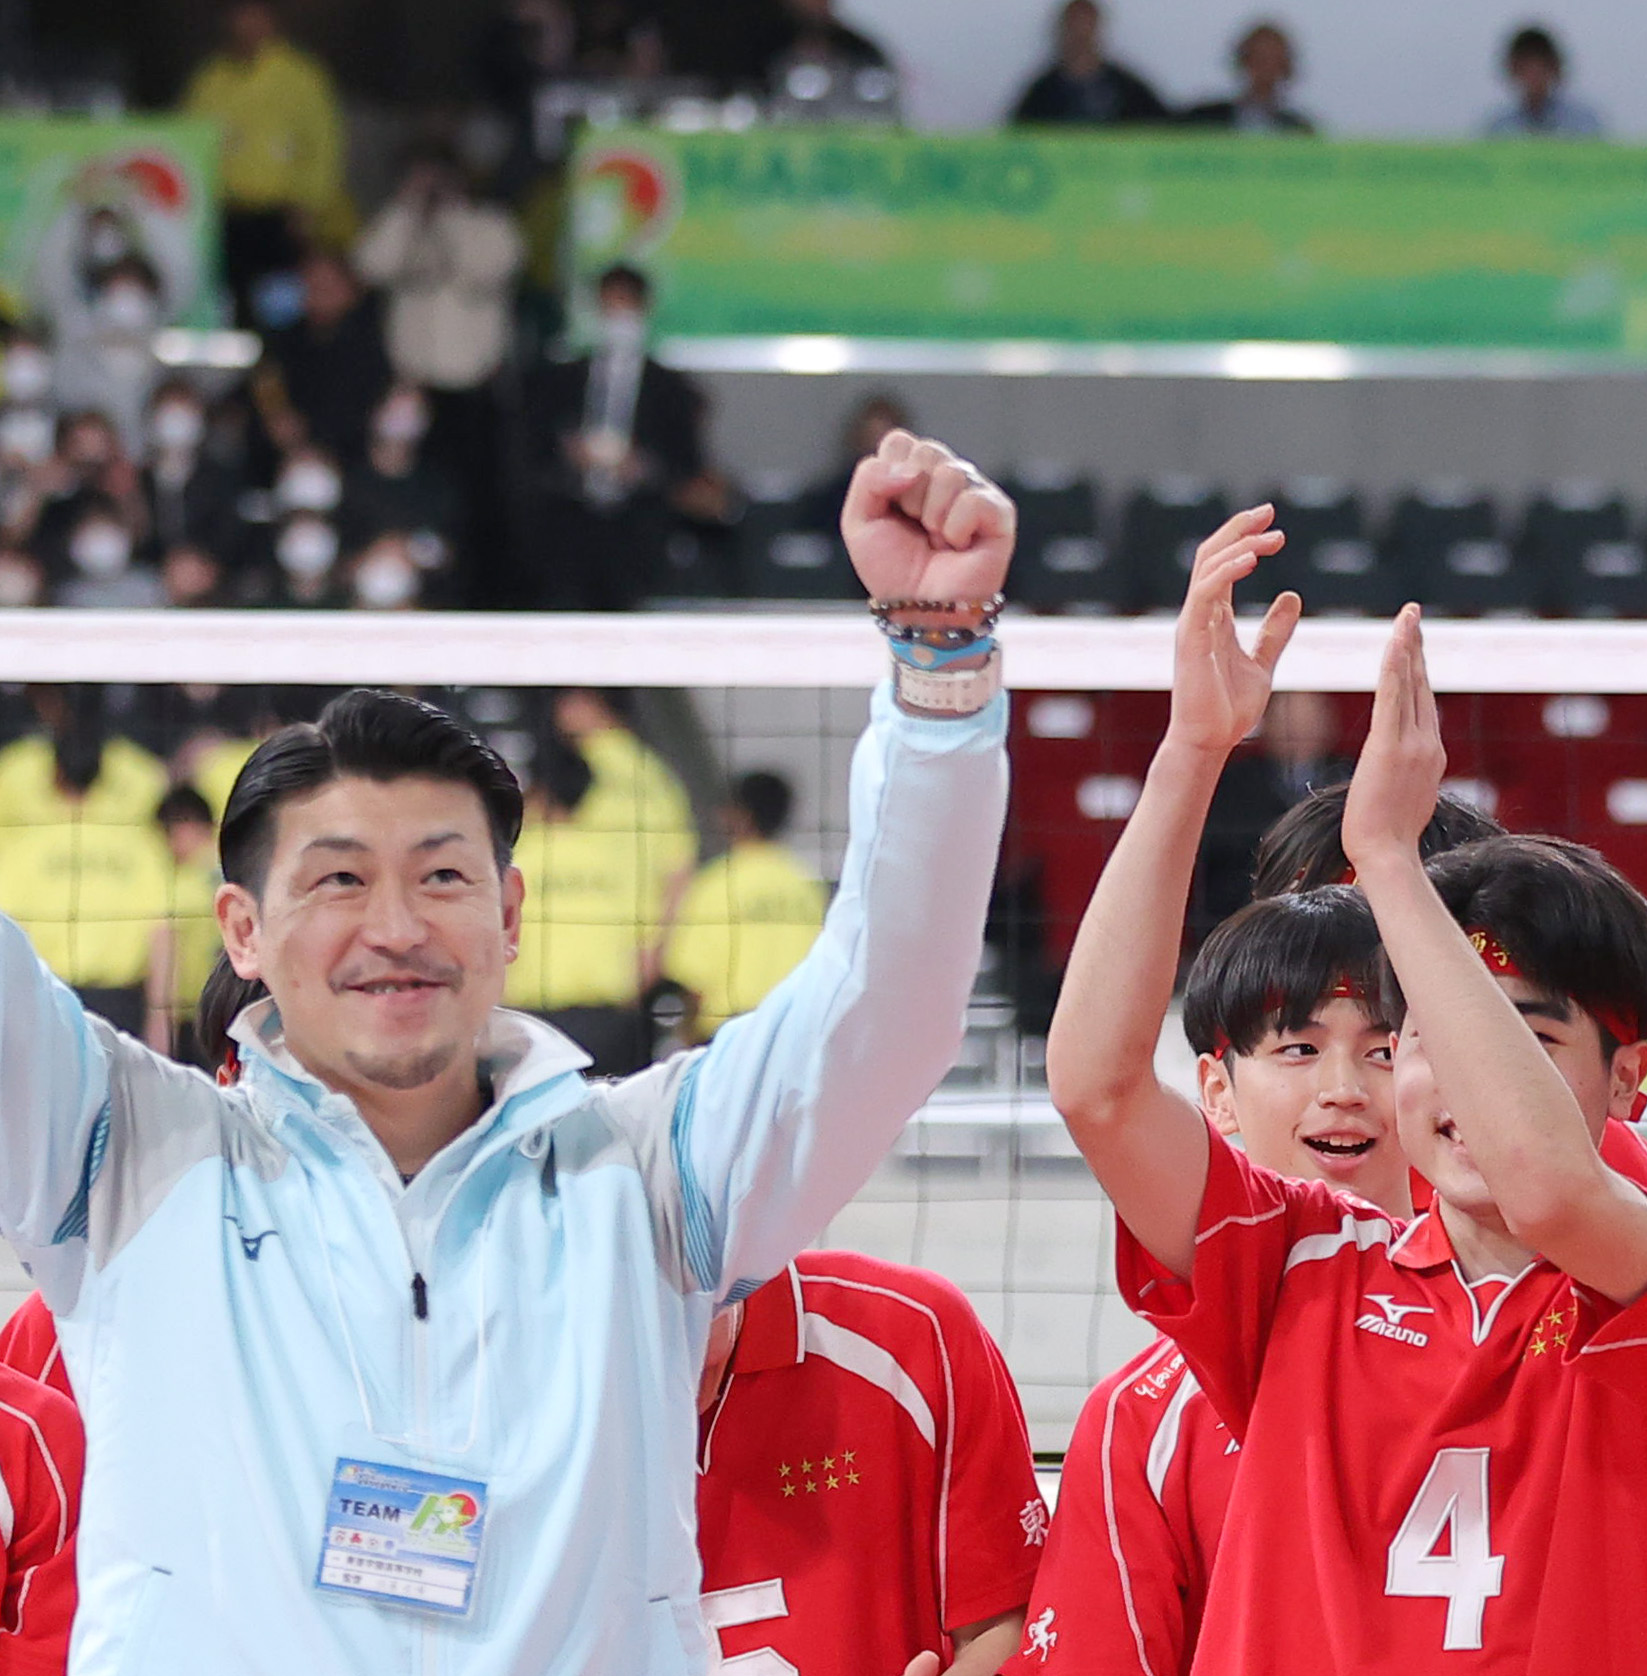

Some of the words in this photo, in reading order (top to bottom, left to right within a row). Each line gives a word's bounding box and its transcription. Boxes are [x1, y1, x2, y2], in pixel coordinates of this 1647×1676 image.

[1354, 1312, 1428, 1348] MIZUNO
[340, 1499, 401, 1523] TEAM
[1384, 1447, 1505, 1652] 4
